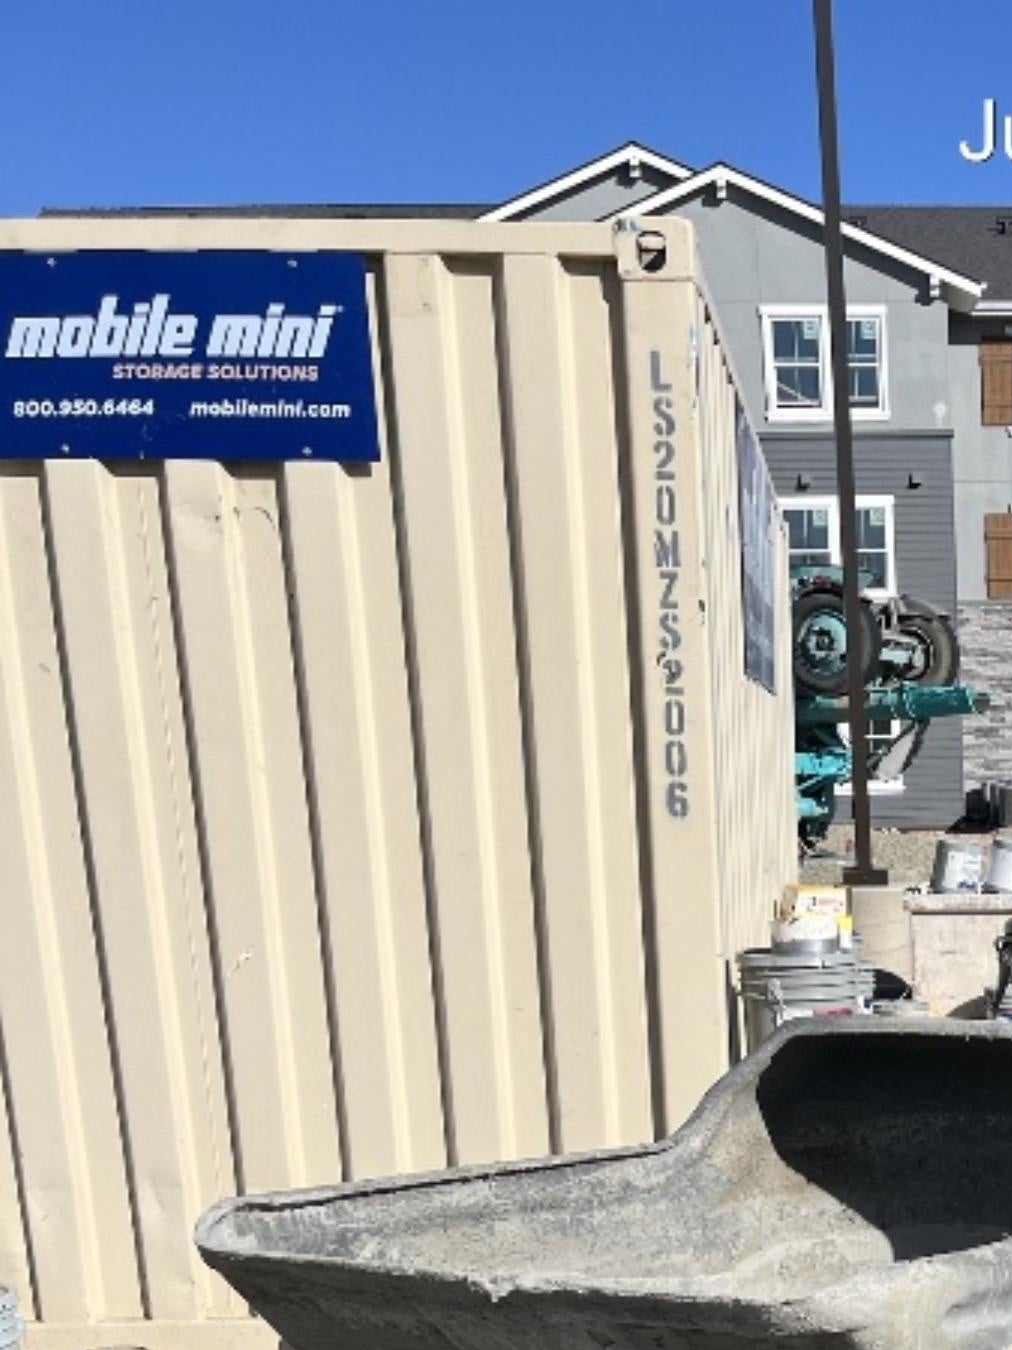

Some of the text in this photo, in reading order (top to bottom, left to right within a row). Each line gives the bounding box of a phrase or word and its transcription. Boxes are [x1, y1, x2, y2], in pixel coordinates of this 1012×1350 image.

[5, 293, 336, 358] mobile mini
[112, 363, 319, 382] STORAGE SOLUTIONS
[13, 399, 154, 417] 800.950.6464
[189, 398, 351, 419] mobilemini.com
